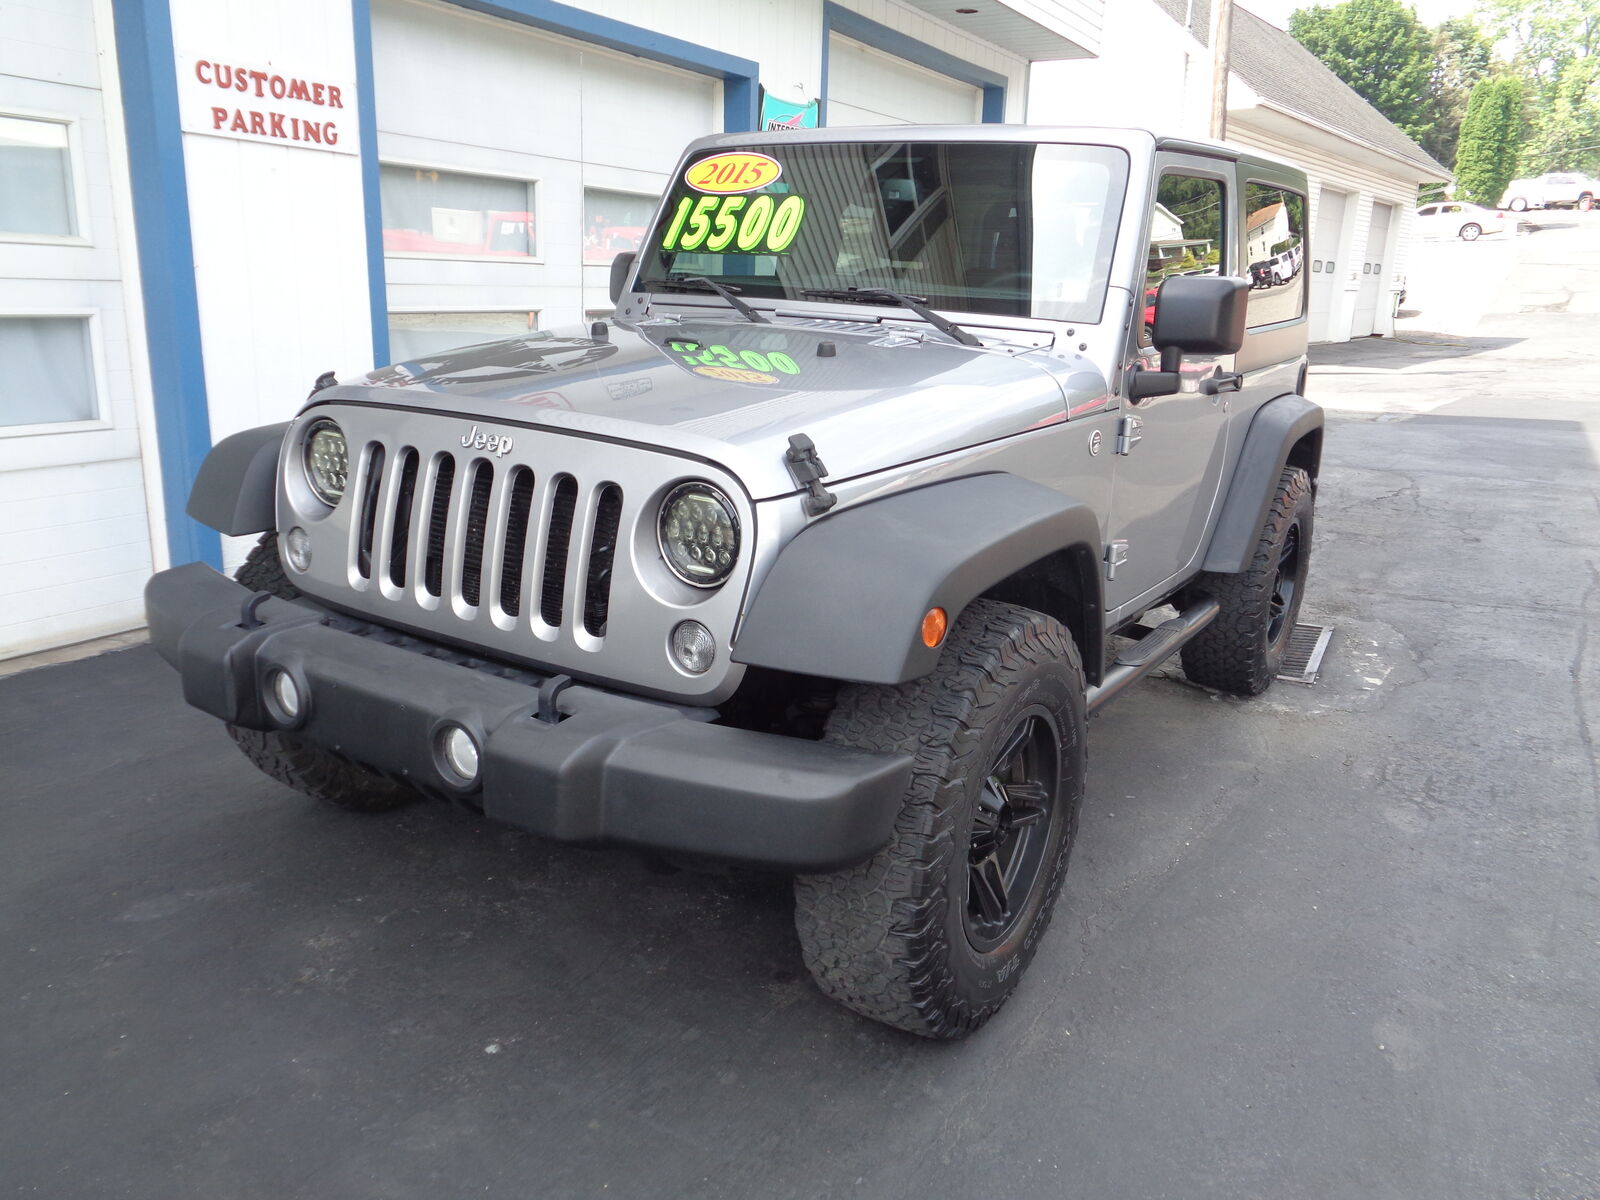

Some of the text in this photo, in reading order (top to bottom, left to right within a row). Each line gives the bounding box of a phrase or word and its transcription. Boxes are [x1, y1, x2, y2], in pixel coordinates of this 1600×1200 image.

[196, 60, 344, 108] CUSTOMER
[211, 107, 338, 145] PARKING
[697, 162, 768, 184] 2015
[662, 195, 805, 252] 15500
[461, 425, 514, 458] Jeep
